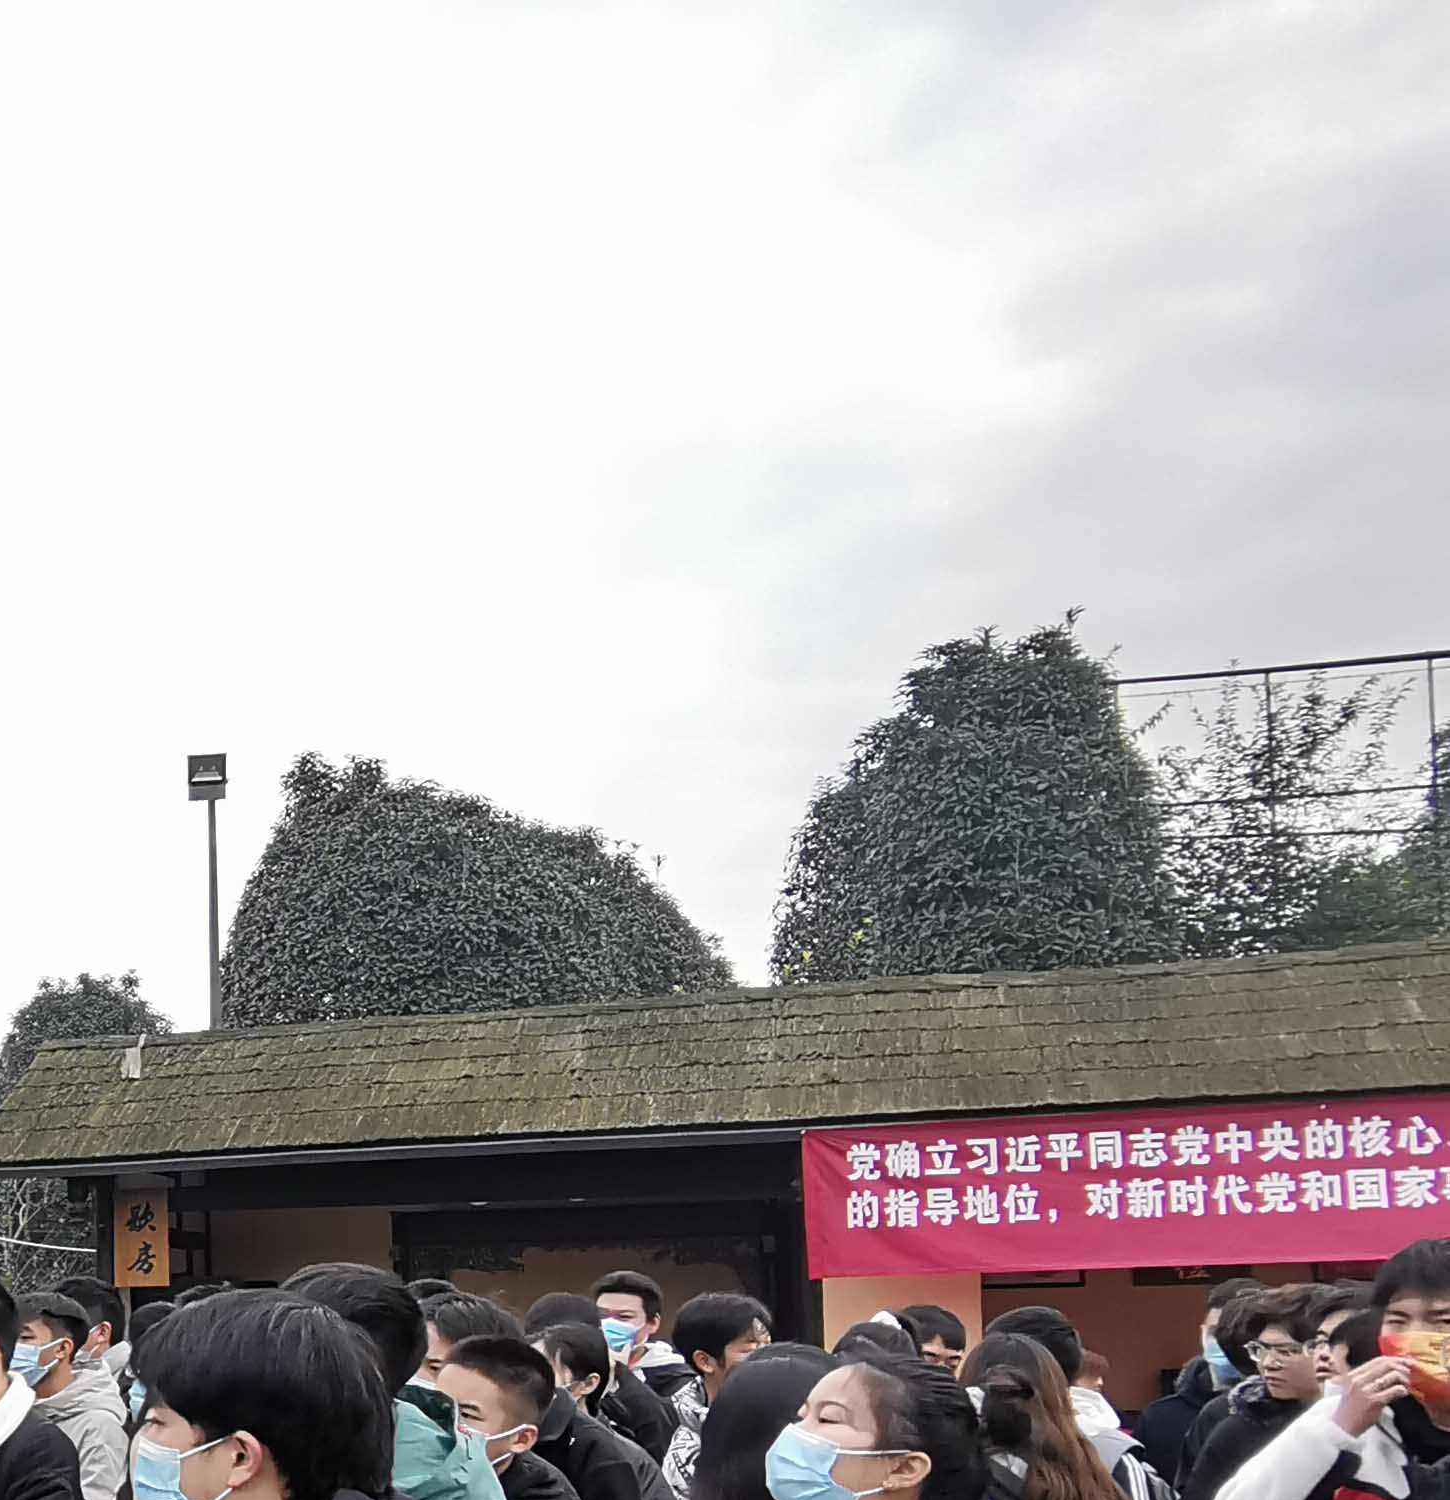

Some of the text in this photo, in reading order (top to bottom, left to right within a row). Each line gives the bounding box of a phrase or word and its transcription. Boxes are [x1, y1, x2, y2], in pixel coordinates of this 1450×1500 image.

[845, 1114, 1443, 1181] 党确立习近平同志党中央的核心
